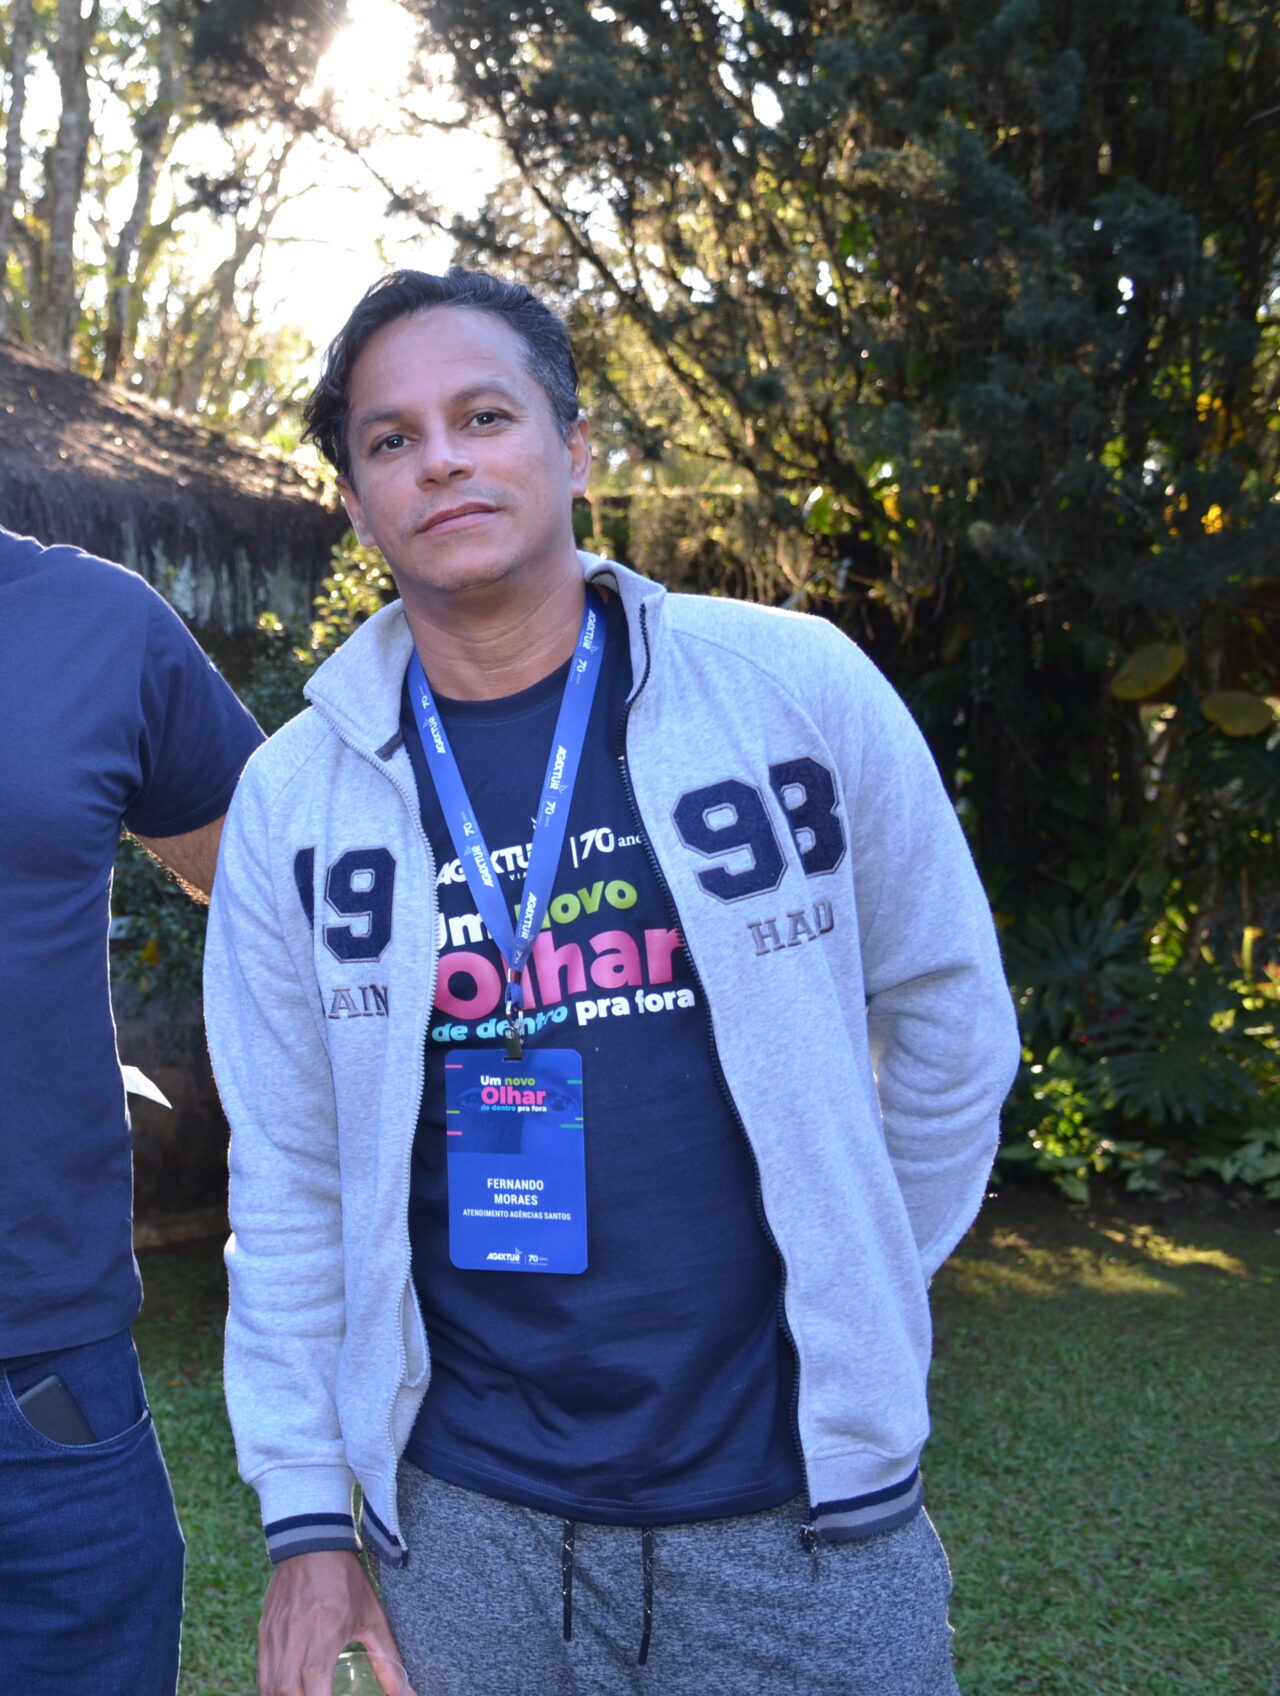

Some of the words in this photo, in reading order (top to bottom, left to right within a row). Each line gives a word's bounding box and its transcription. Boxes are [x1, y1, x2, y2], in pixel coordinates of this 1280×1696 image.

[576, 658, 587, 673] 70
[545, 801, 556, 815] 70
[463, 822, 475, 836] 70
[580, 827, 615, 860] 70
[431, 1023, 468, 1042] de
[575, 997, 630, 1026] pra
[635, 987, 695, 1014] fora
[480, 1075, 502, 1086] Um
[504, 1077, 536, 1086] novo
[481, 1086, 547, 1105] Olhar
[517, 1105, 530, 1113] pra
[531, 1104, 547, 1112] fora
[486, 1178, 544, 1191] FERNANDO
[494, 1193, 538, 1206] MORAES
[462, 1208, 509, 1218] ATENDIMENTO
[509, 1210, 543, 1219] AGÊNCIAS
[544, 1212, 572, 1221] SANTOS
[528, 1254, 539, 1262] 70
